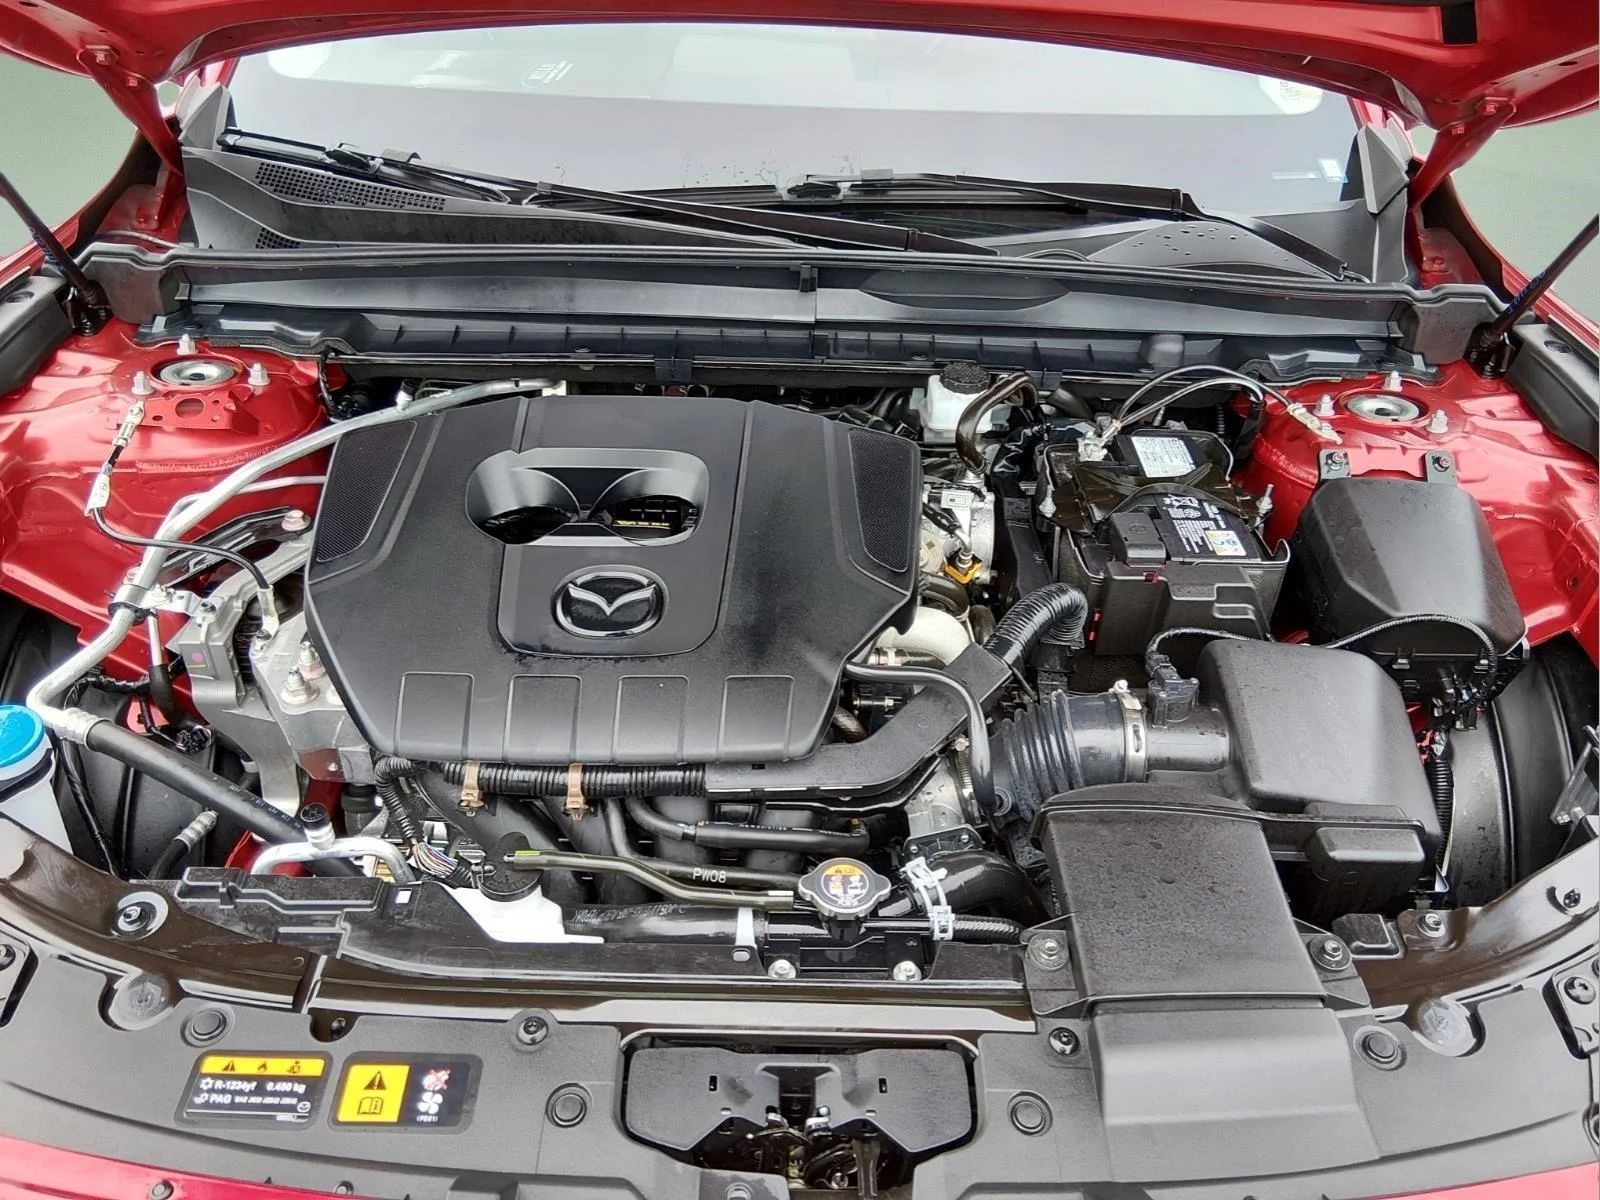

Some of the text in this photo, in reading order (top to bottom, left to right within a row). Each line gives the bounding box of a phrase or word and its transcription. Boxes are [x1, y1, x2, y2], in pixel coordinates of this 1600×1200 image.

[692, 867, 727, 884] PW08
[214, 1079, 257, 1092] R-1234yf
[292, 1082, 306, 1093] kg
[209, 1093, 232, 1104] PAG
